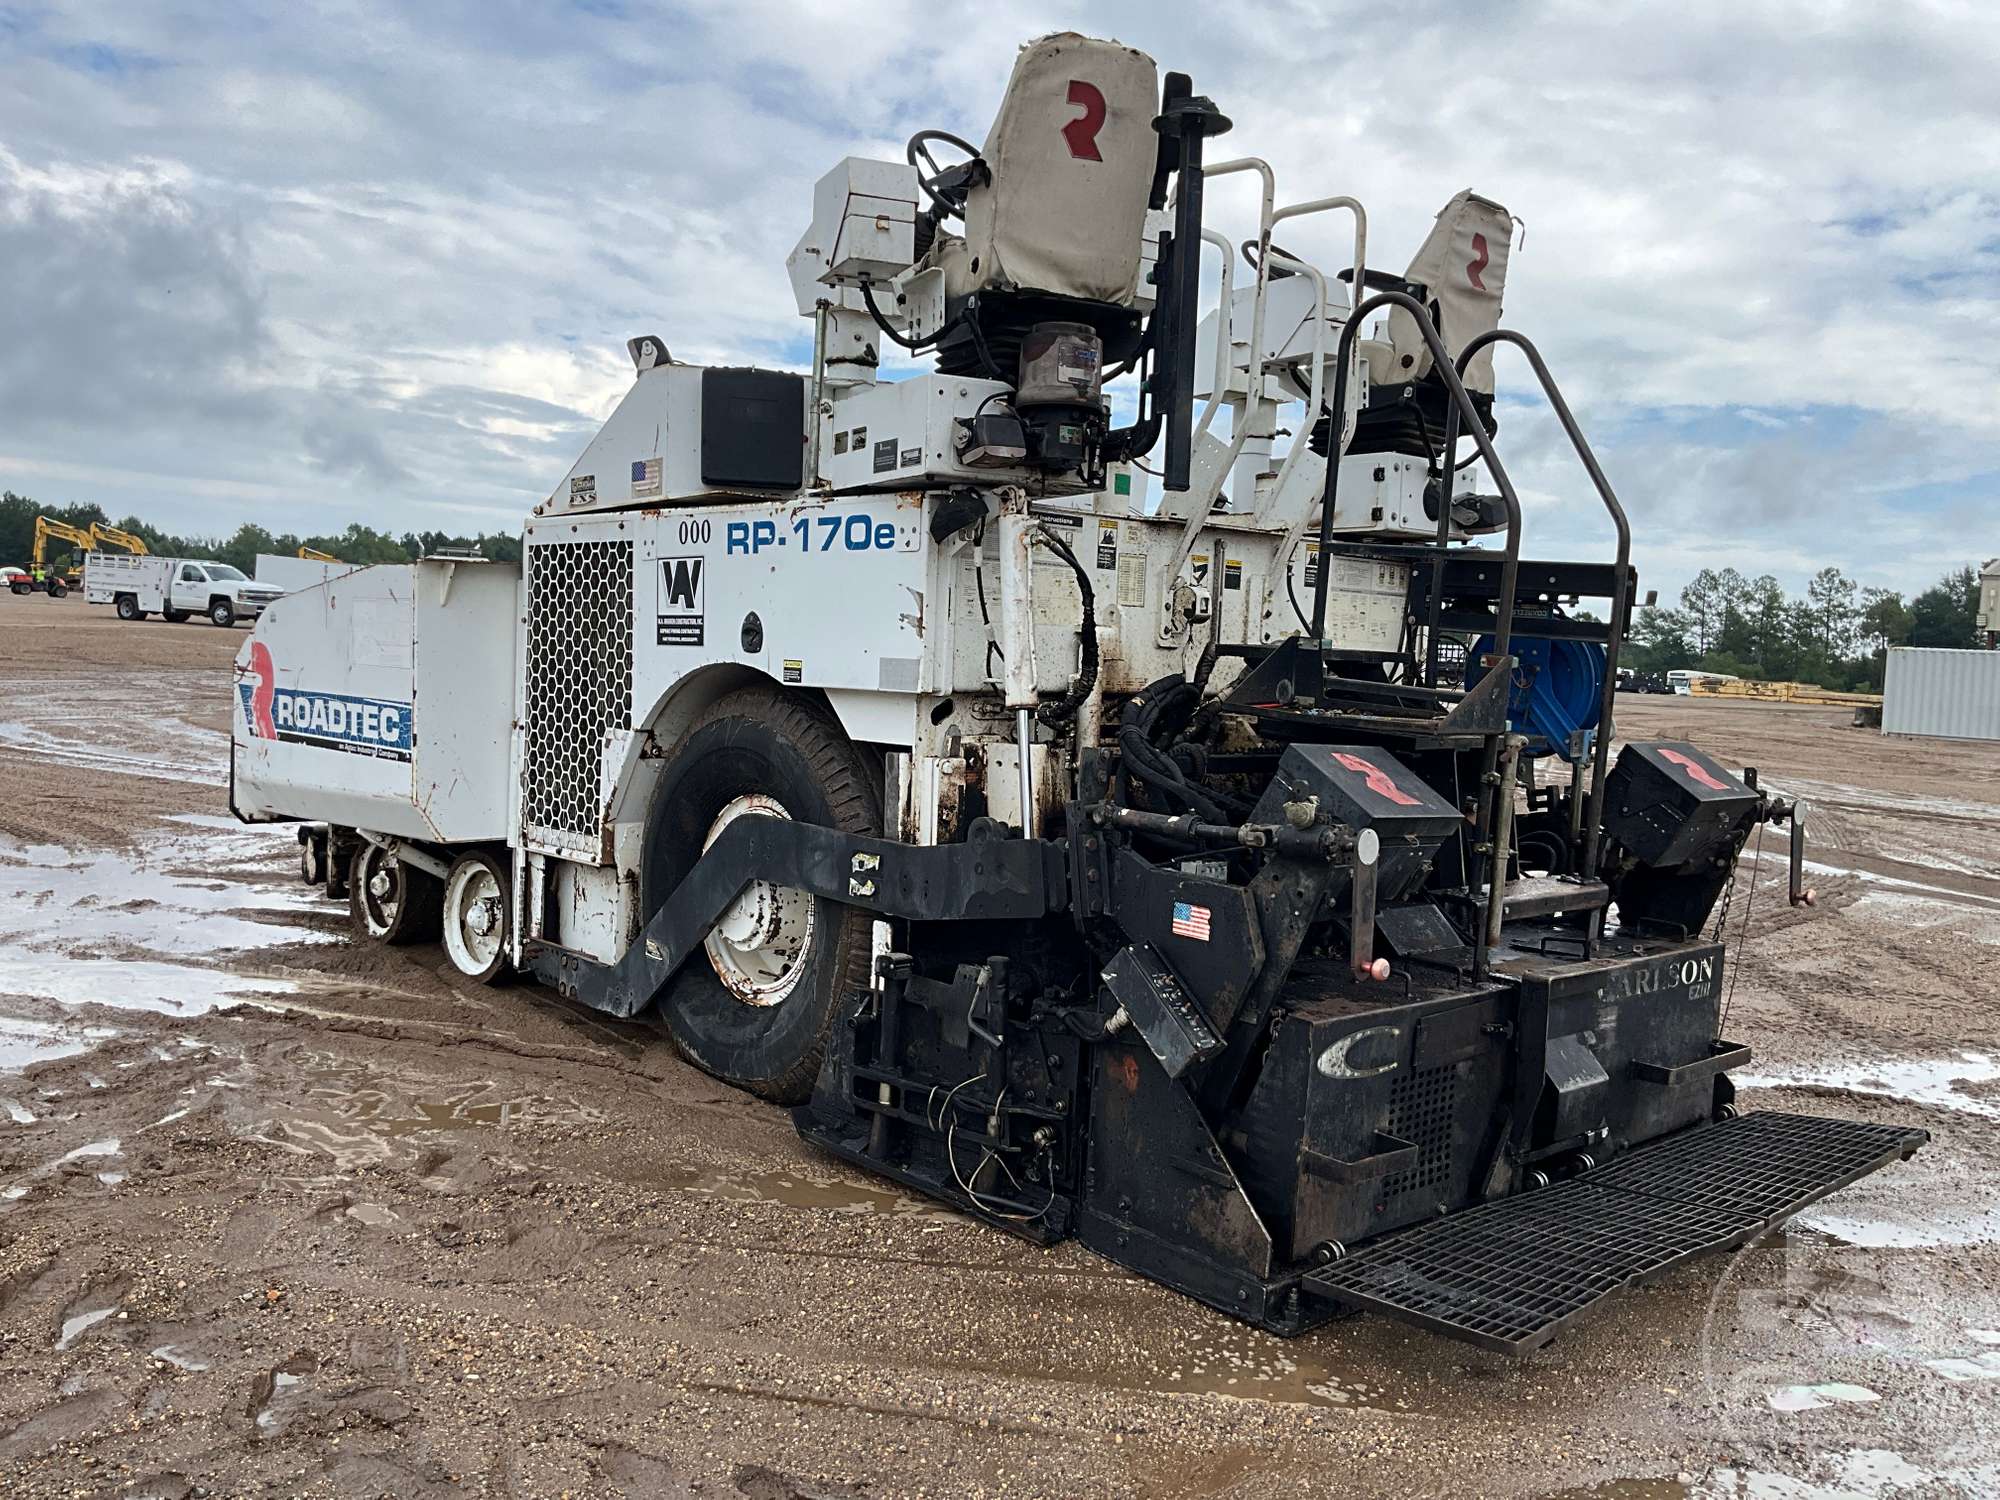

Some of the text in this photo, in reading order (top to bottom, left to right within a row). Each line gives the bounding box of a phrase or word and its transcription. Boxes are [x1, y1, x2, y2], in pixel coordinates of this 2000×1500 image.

[727, 514, 895, 555] RP-170e
[277, 694, 400, 742] ROADTEC
[1597, 956, 1715, 1003] ARLSON
